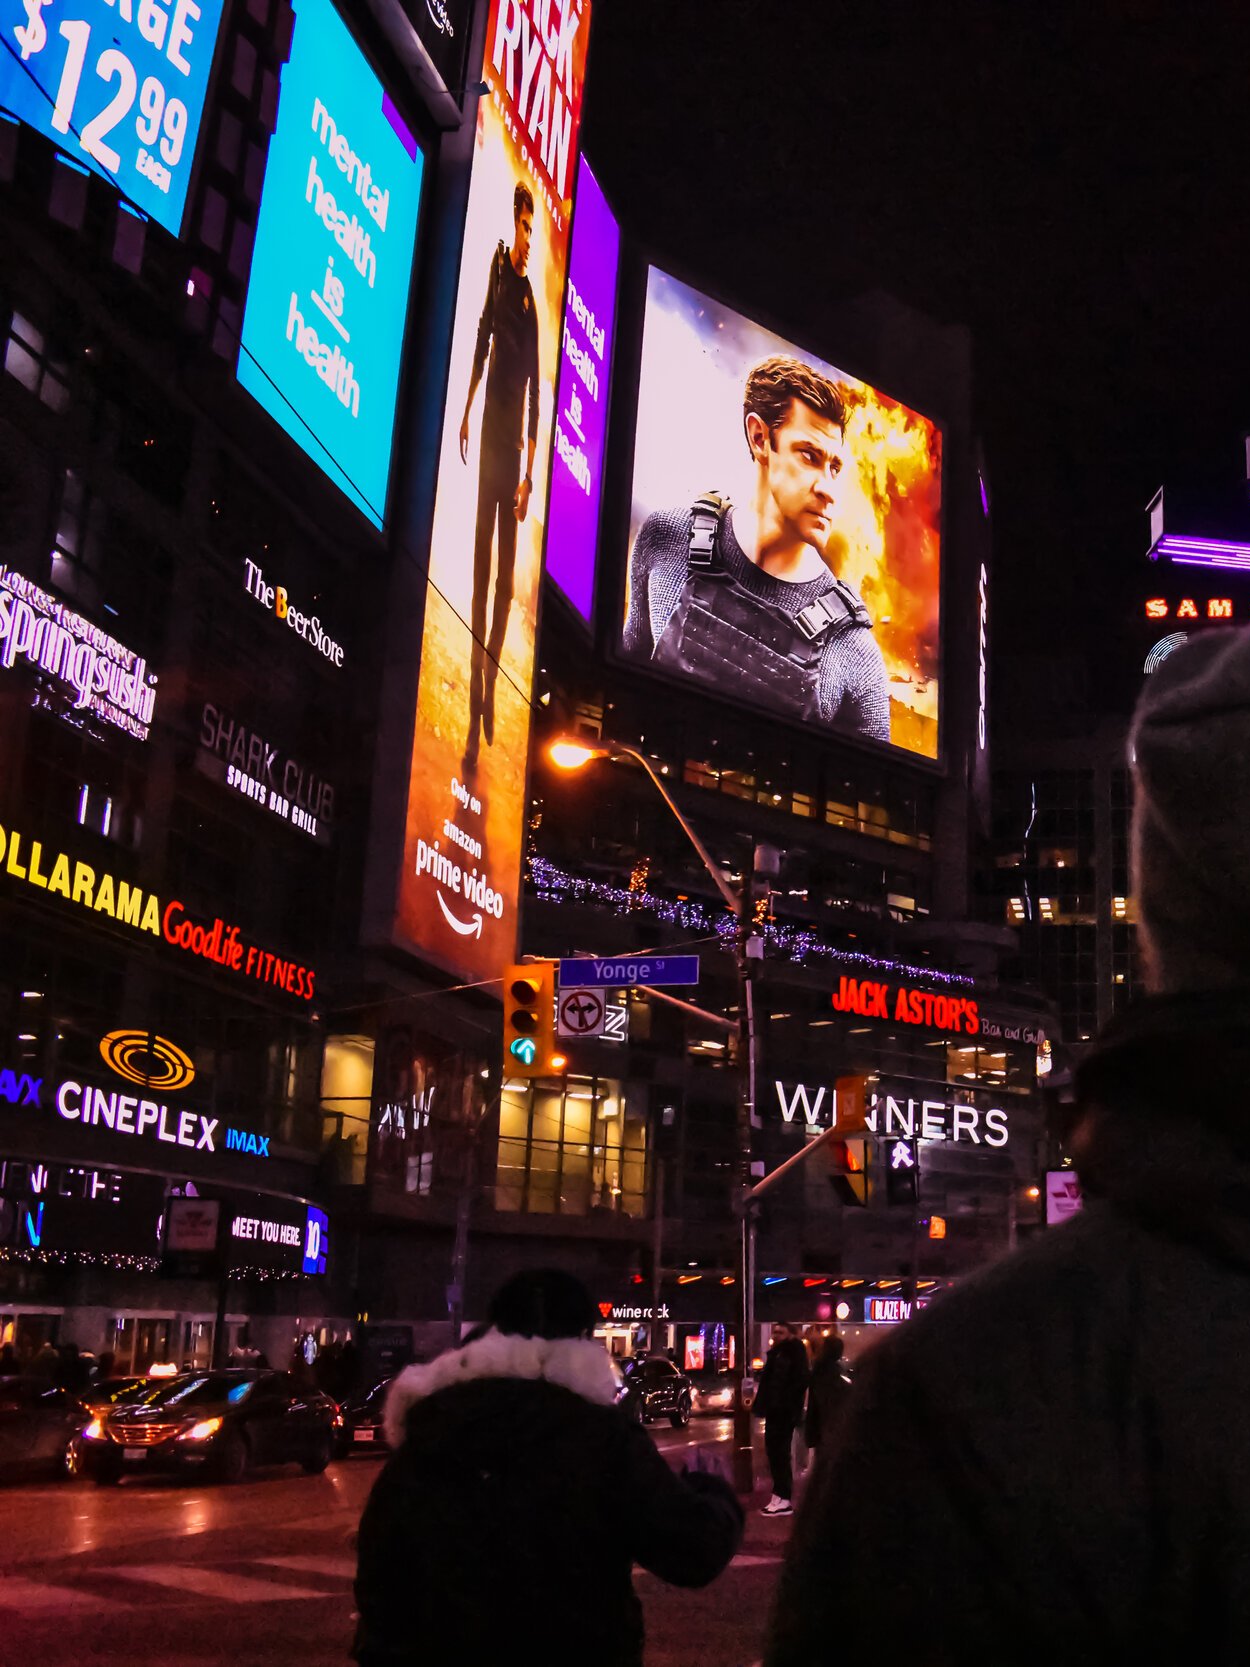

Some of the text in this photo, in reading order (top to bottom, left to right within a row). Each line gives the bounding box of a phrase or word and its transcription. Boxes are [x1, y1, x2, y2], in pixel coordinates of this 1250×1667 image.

[107, 0, 201, 76] GE
[491, 0, 574, 202] RYAN
[136, 148, 172, 194] EACH
[311, 97, 390, 233] mental
[521, 145, 562, 232] ORIGINAL
[305, 156, 377, 289] health
[323, 256, 345, 317] is
[286, 291, 360, 419] health
[562, 316, 599, 402] health
[570, 382, 583, 426] is
[554, 413, 591, 497] health
[243, 557, 345, 668] The Beer Store
[1145, 598, 1233, 618] SAM
[200, 703, 335, 823] SHARK CLUB
[451, 777, 482, 815] Only on
[226, 764, 317, 836] SPORTS BAR GRILL
[443, 818, 482, 860] amazon
[0, 822, 160, 936] LLARAMA
[415, 838, 504, 919] prime video
[163, 900, 316, 1000] GoodLife FITNESS
[593, 961, 651, 984] Yonge
[832, 975, 979, 1034] JACK ASTOR'S
[57, 1080, 219, 1152] CINEPLEX
[226, 1128, 271, 1157] IMAX
[261, 1220, 280, 1243] YOU
[305, 1219, 321, 1260] 10
[612, 1303, 642, 1319] wine
[875, 1300, 900, 1320] BLAZE
